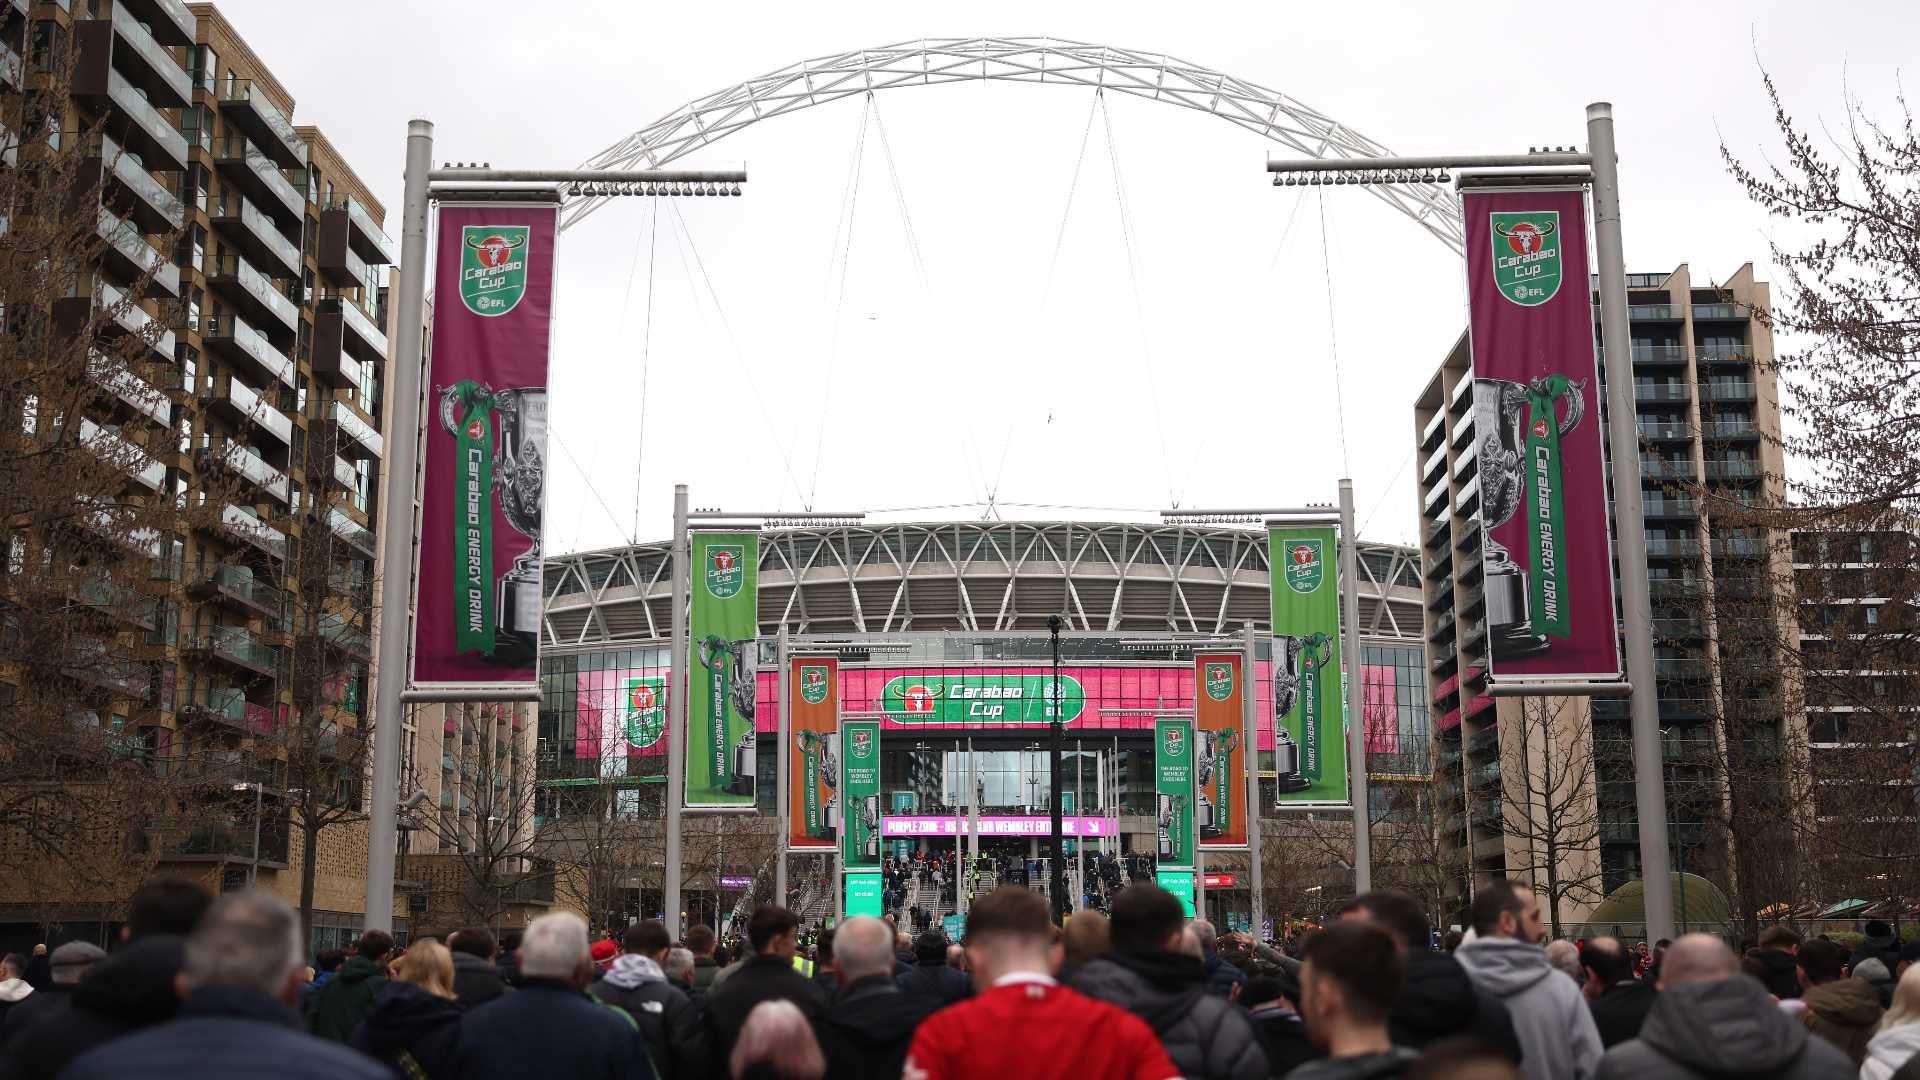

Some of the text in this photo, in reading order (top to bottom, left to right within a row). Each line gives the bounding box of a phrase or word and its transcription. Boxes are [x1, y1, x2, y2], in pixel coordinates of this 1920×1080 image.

[1498, 248, 1556, 268] Carabao
[465, 262, 521, 280] Carabao
[1514, 264, 1541, 278] Cup
[480, 276, 506, 288] Cup
[1528, 288, 1544, 296] EFL
[468, 448, 482, 632] Carabao ENERGY DRINK
[1535, 446, 1558, 622] Carabao ENERGY DRINK
[708, 566, 740, 578] Carabao
[1288, 560, 1320, 572] Carabao
[950, 684, 1024, 698] Carabao
[1306, 672, 1314, 714] Carabao
[970, 702, 1004, 719] Cup
[1046, 706, 1064, 716] EL
[714, 674, 724, 776] Carabao ENERGY DRINK
[1306, 714, 1315, 746] ENERGY
[888, 820, 917, 832] PURPLE
[918, 820, 939, 832] ZONE
[944, 820, 956, 832] US
[995, 820, 1035, 832] WEMBLEY
